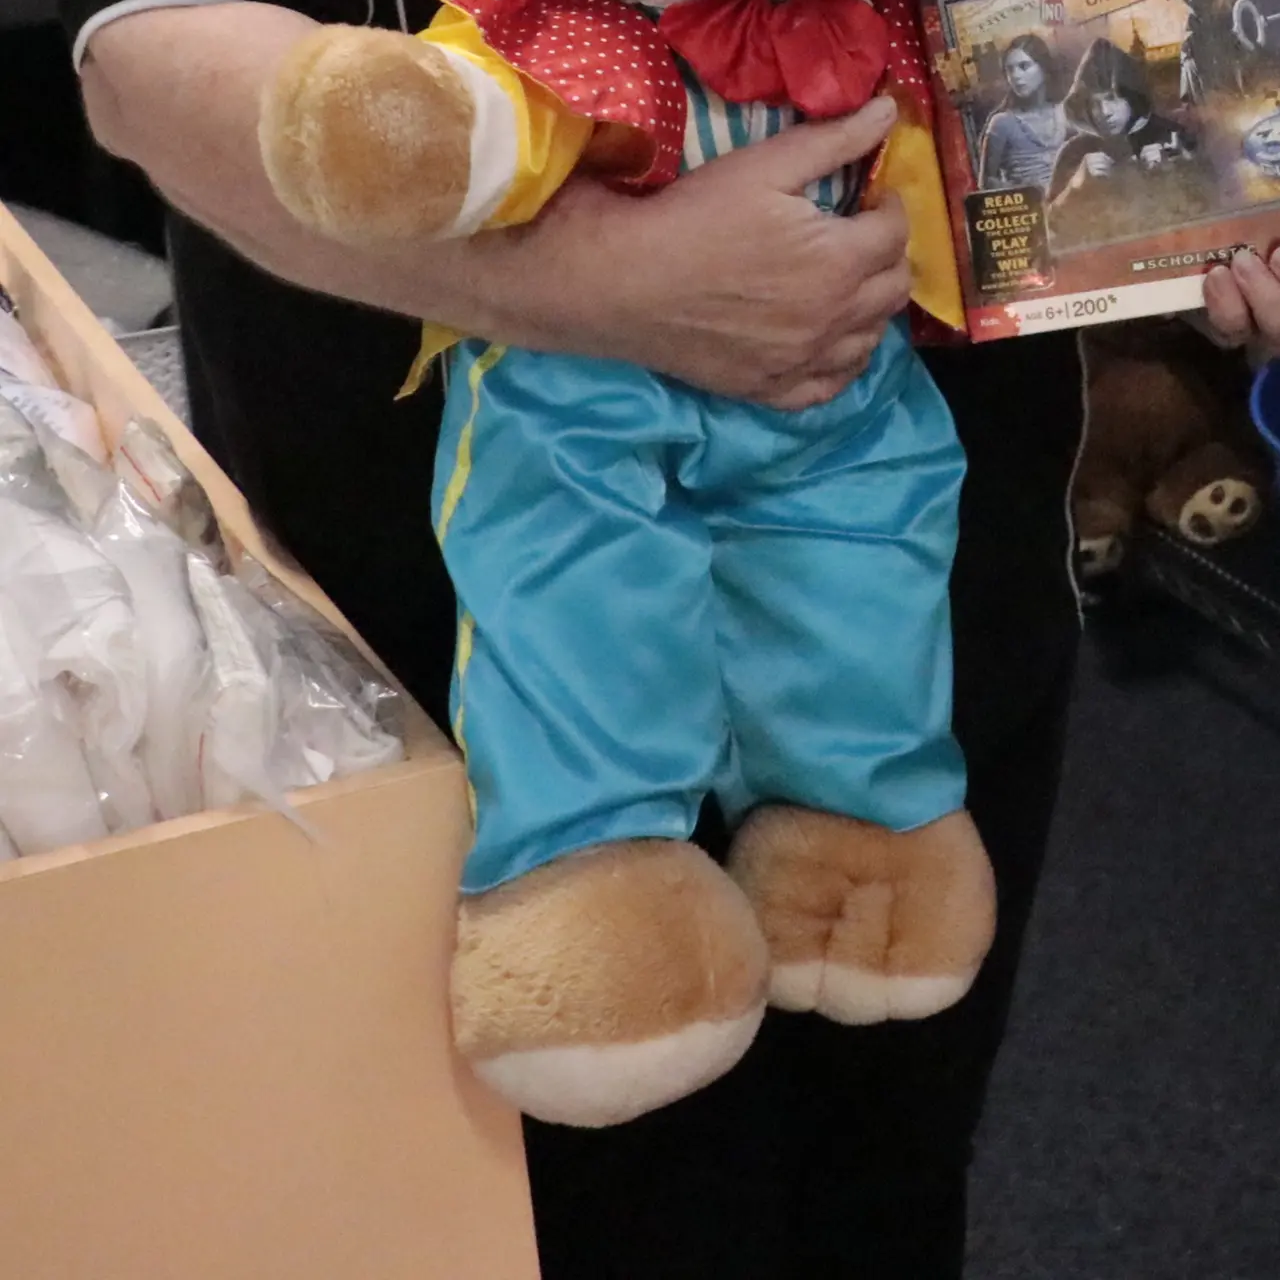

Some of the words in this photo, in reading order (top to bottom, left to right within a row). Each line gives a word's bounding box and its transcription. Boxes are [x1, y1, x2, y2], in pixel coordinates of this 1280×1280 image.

[1043, 2, 1063, 21] NO
[984, 193, 1024, 209] READ
[975, 212, 1038, 232] COLLECT
[991, 236, 1028, 251] PLAY
[997, 257, 1028, 271] WIN
[1147, 244, 1257, 270] SCHOLASTC
[1072, 297, 1108, 318] 200
